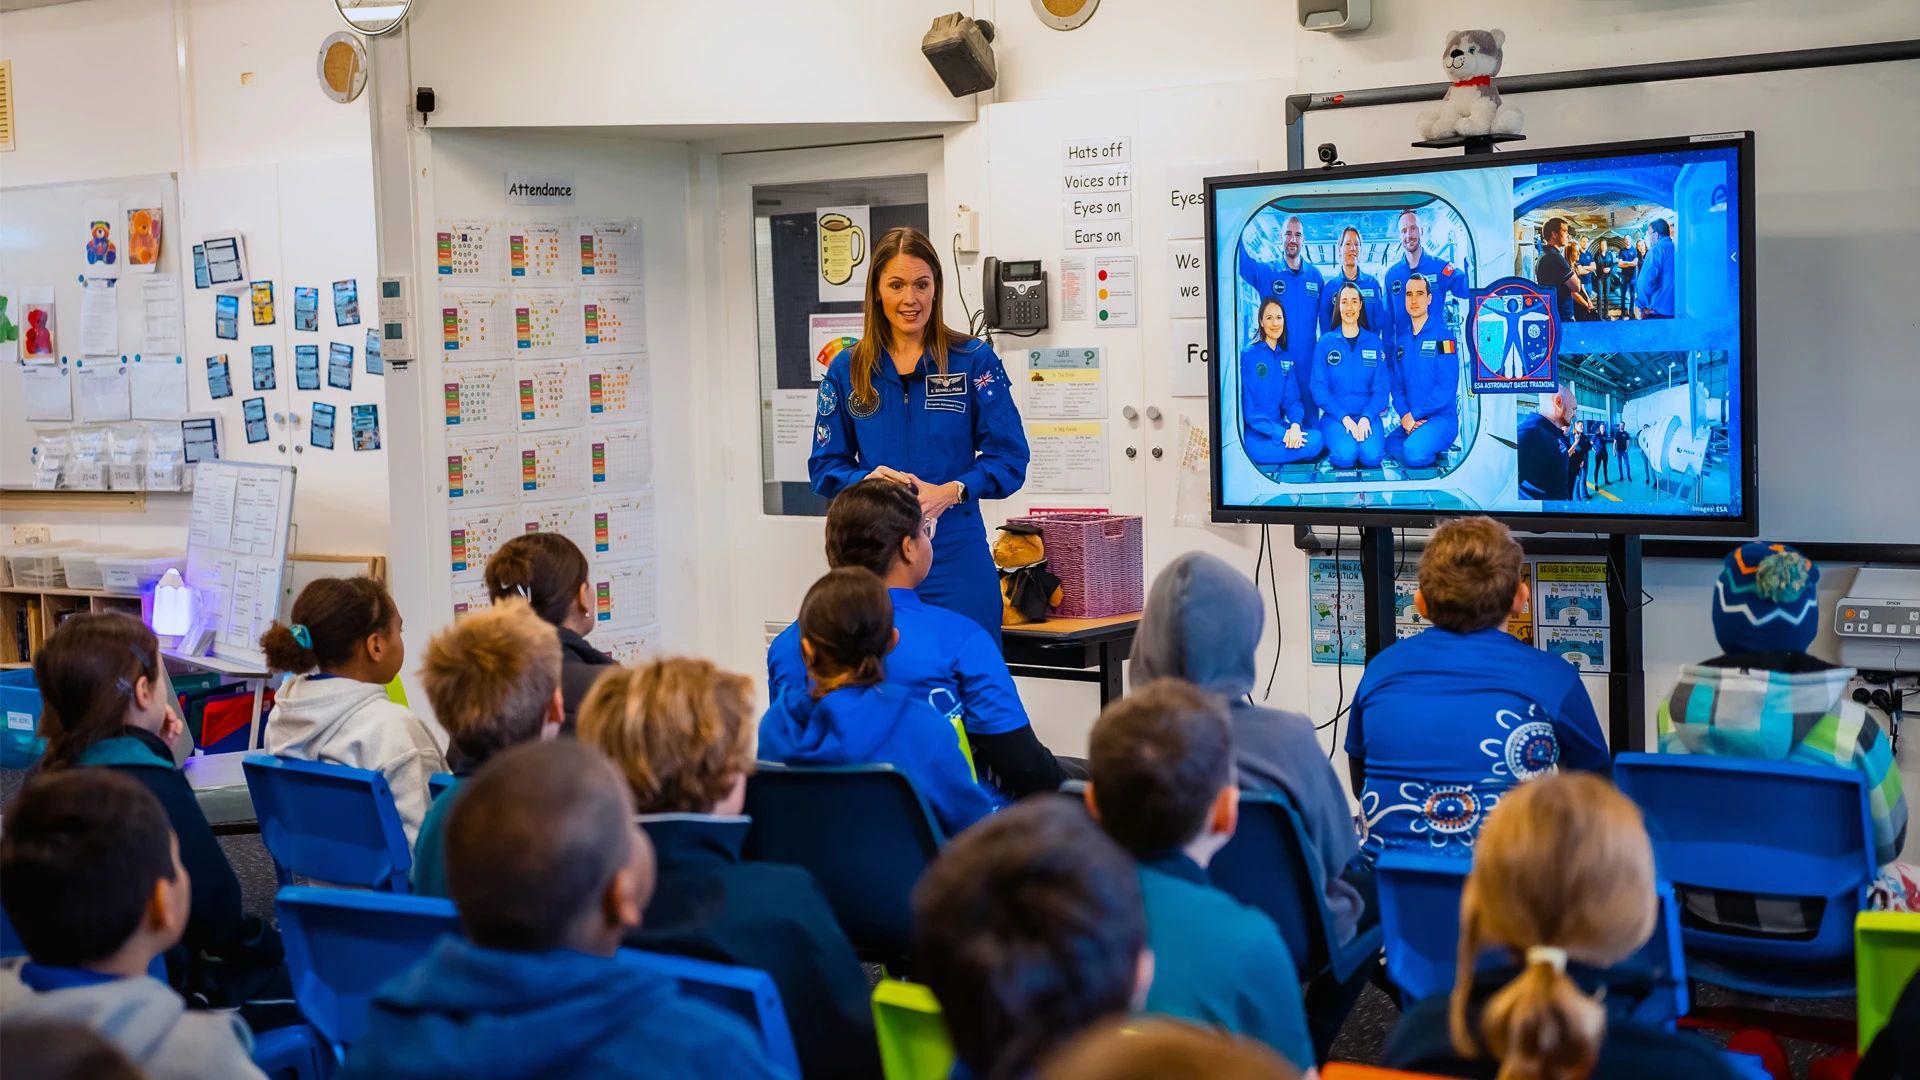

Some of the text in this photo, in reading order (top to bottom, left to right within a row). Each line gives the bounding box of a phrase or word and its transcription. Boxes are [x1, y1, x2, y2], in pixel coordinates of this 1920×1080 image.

[1068, 142, 1122, 159] Hats off
[1064, 172, 1128, 189] Voices off
[509, 182, 572, 196] Attendance
[1171, 190, 1204, 210] Eyes
[1074, 200, 1121, 218] Eyes on
[1075, 229, 1121, 244] Ears on
[1175, 254, 1200, 269] We
[1180, 286, 1200, 297] we
[1056, 350, 1070, 358] QAR
[1484, 381, 1513, 389] ASTRONAUT
[1318, 562, 1352, 571] CHUNING
[1540, 565, 1559, 573] BRIDGE
[1560, 565, 1574, 573] BACK
[1575, 565, 1601, 574] THROUGH
[1327, 572, 1359, 580] ADITION
[1569, 597, 1578, 605] 10
